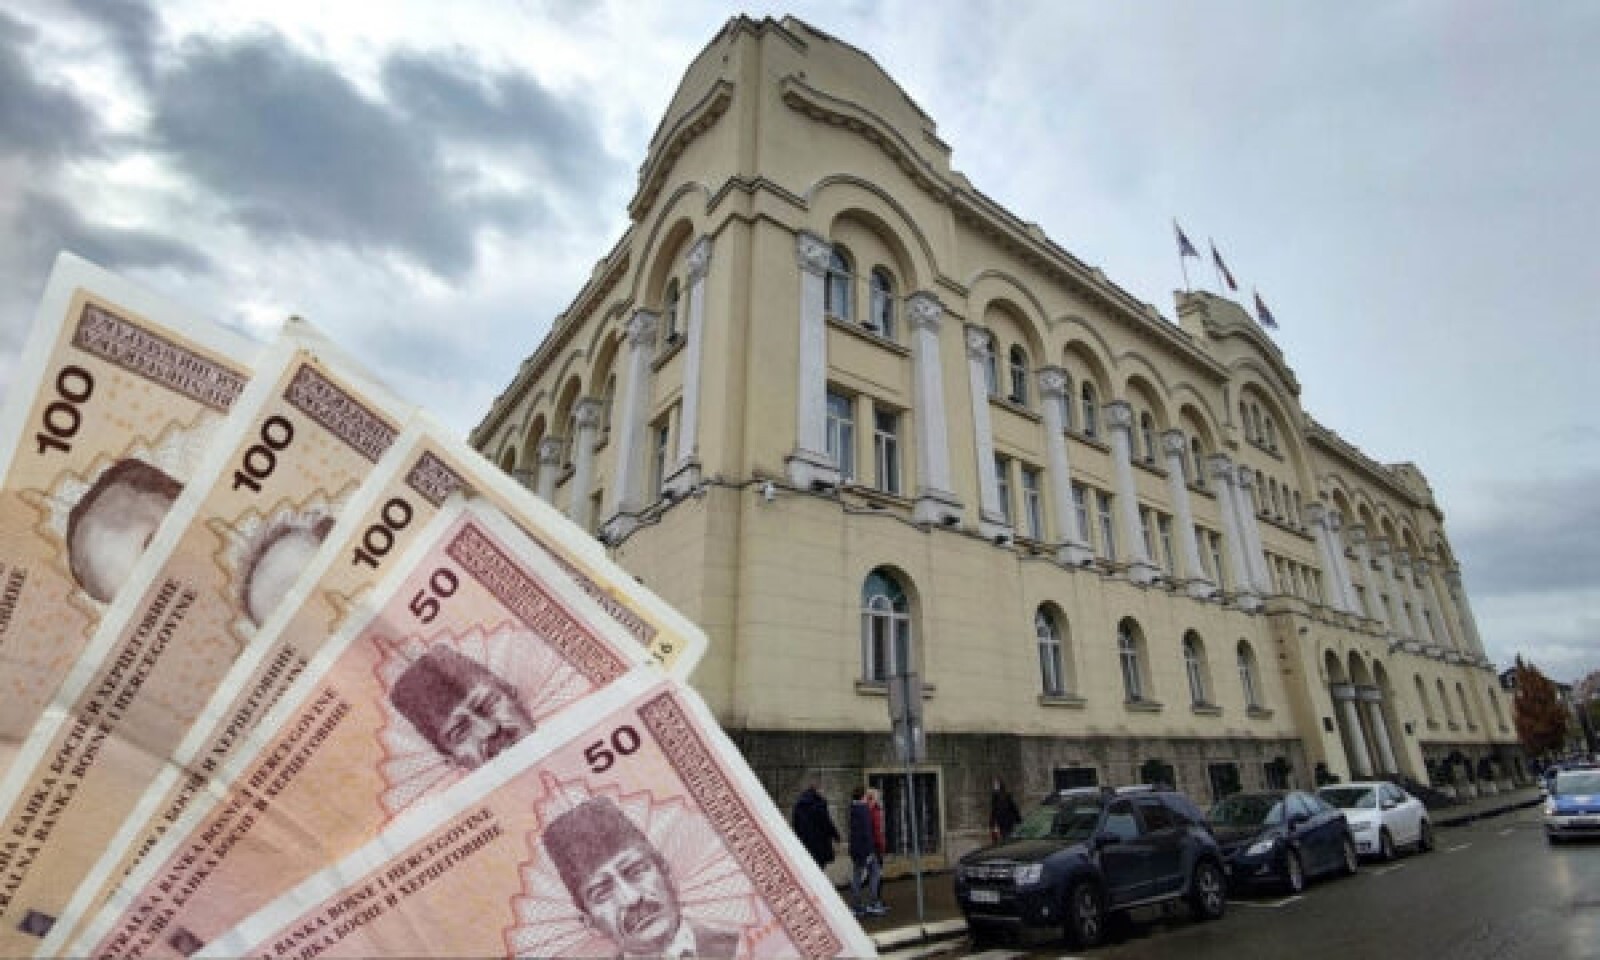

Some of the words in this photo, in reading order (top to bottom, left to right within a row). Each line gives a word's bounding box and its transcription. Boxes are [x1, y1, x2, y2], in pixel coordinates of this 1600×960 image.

[36, 364, 95, 454] 100
[232, 415, 295, 493] 100
[352, 497, 413, 569] 100
[408, 567, 459, 624] 50
[584, 725, 641, 774] 50
